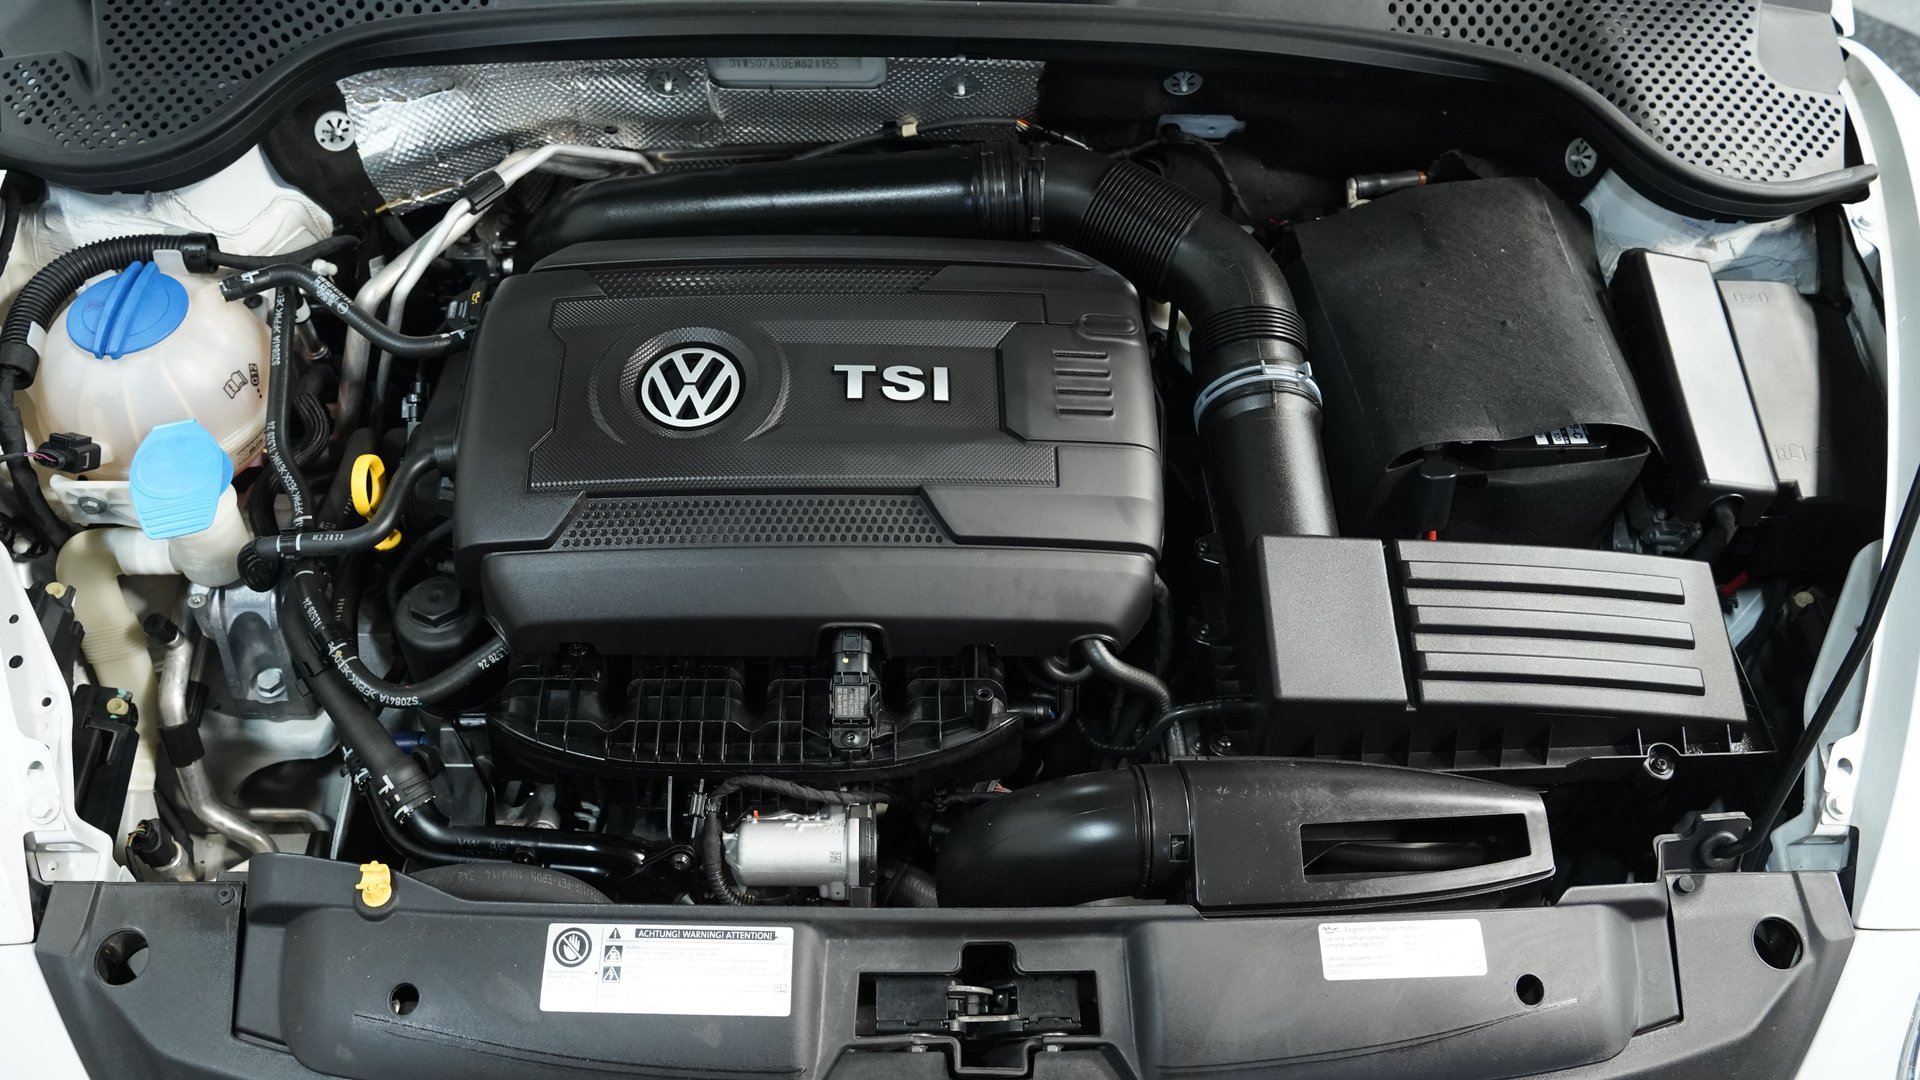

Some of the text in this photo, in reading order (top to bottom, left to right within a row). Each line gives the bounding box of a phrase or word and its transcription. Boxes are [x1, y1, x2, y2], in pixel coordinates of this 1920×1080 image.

[833, 364, 950, 402] TSI
[379, 693, 419, 706] S20841A
[638, 929, 773, 940] ACHTUNG! WARNING! ATTENTION!
